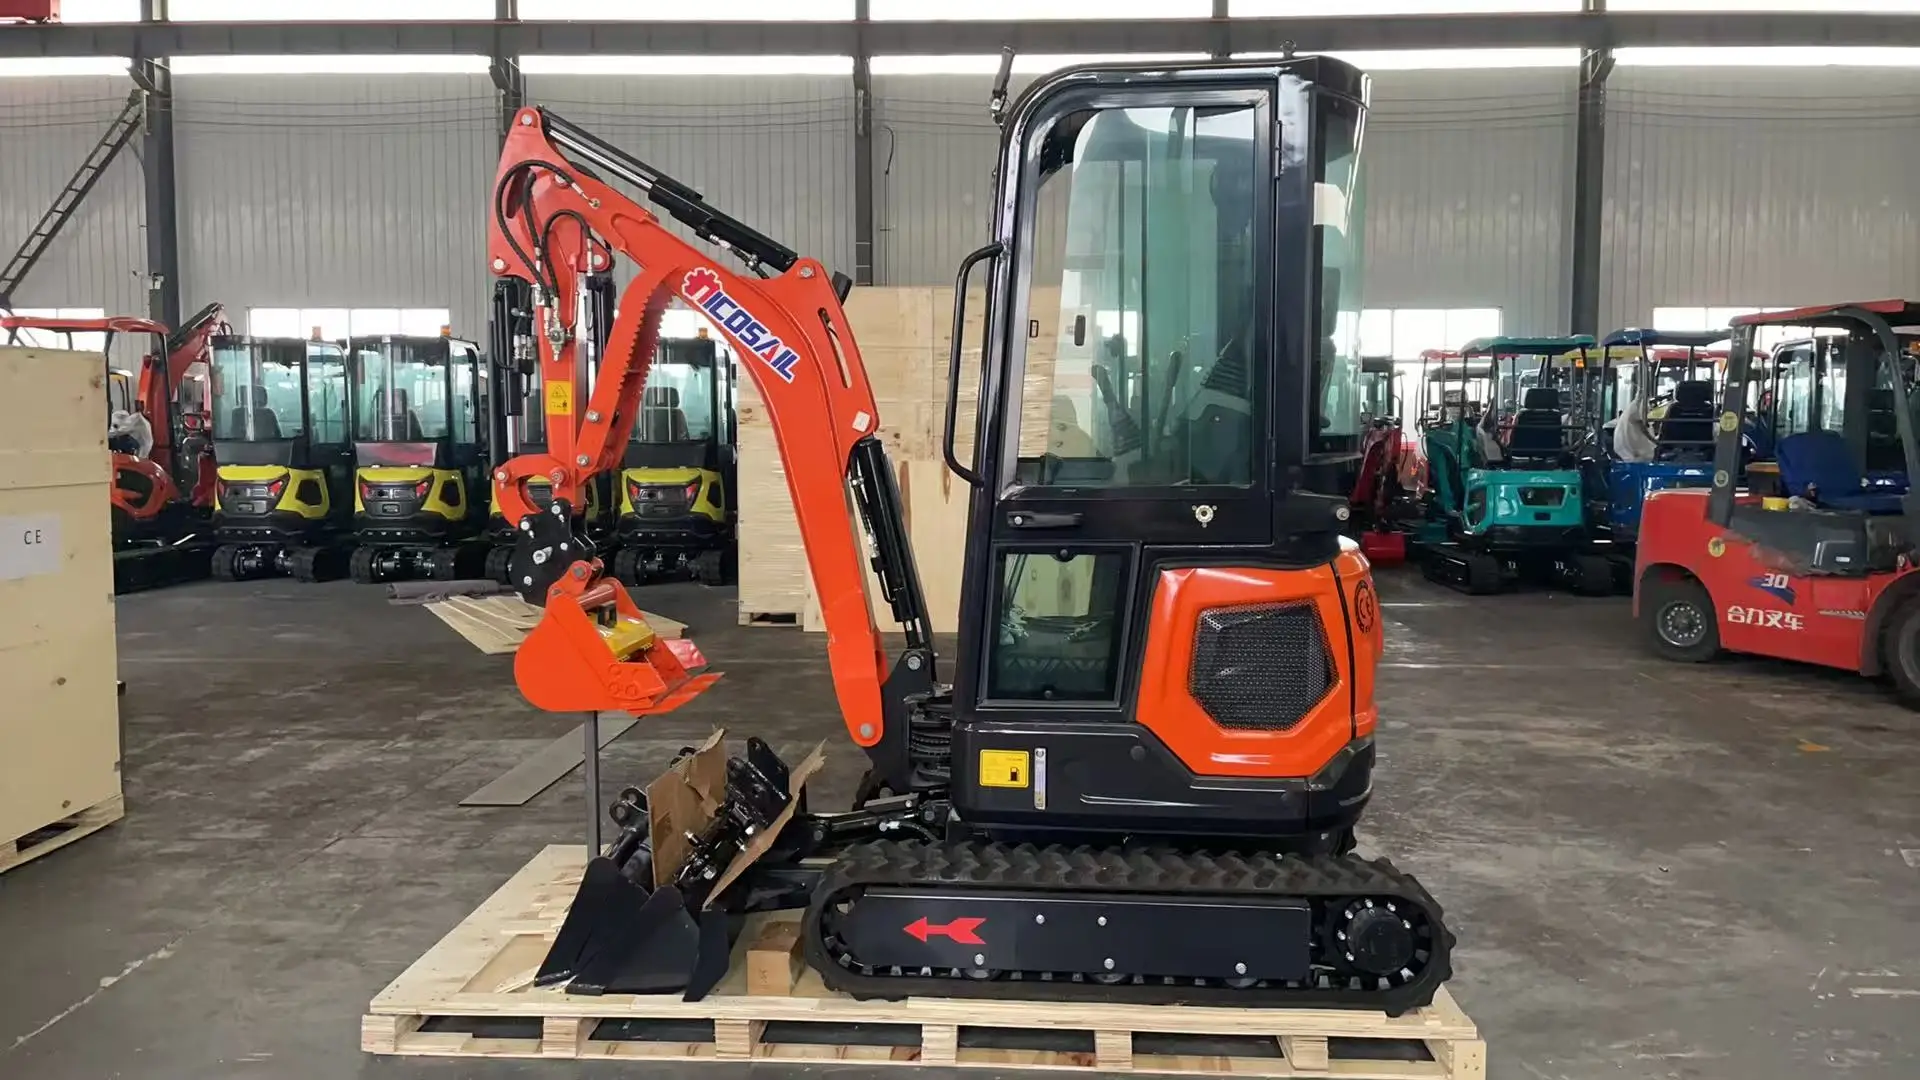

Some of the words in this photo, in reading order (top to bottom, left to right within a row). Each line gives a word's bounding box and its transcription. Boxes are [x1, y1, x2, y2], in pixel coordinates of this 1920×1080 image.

[1760, 573, 1789, 589] 30
[1727, 605, 1804, 631] 合力叉车
